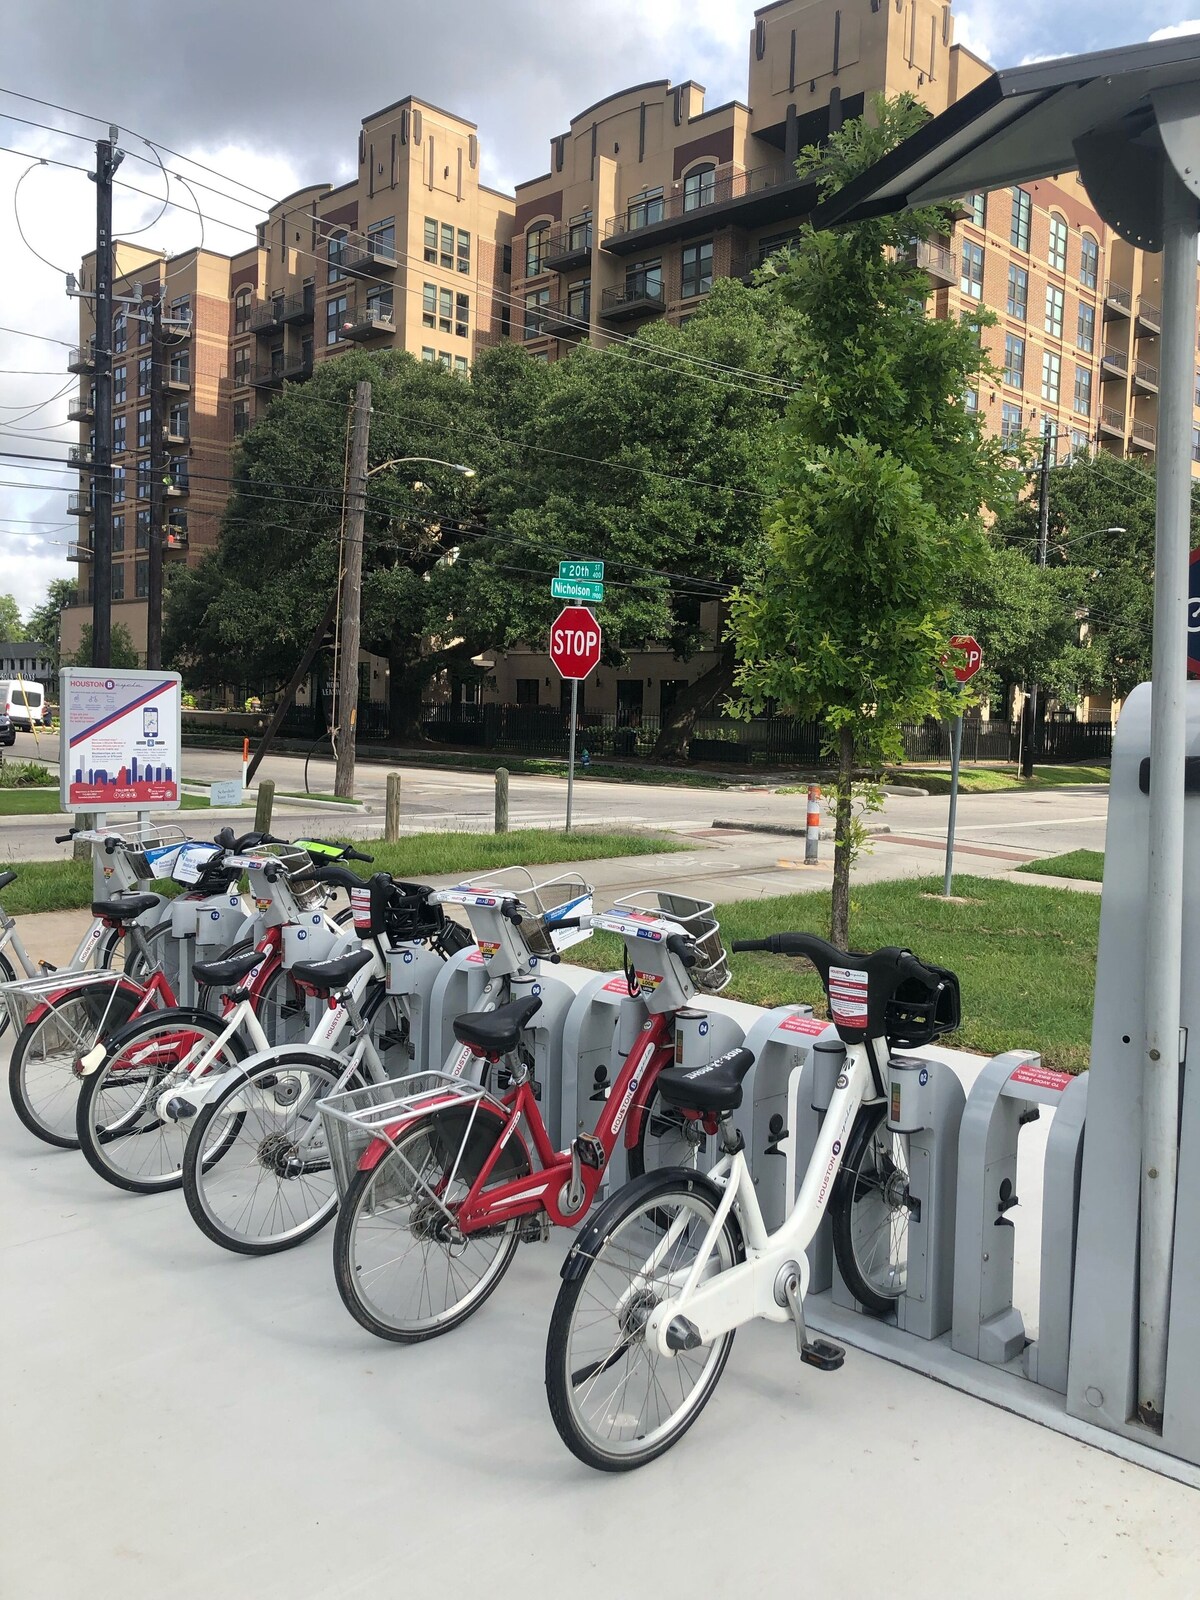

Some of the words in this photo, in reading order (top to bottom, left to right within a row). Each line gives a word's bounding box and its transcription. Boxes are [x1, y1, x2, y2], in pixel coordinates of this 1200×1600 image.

[569, 565, 589, 576] 20th
[554, 581, 590, 596] Nicholson
[554, 629, 597, 656] STOP
[325, 1009, 344, 1039] HOUSTON
[455, 1047, 471, 1075] OUSTON
[723, 1048, 743, 1060] RIDE
[920, 1074, 926, 1082] 02
[613, 1092, 632, 1132] HOUSTON
[817, 1157, 836, 1204] HOUSTON
